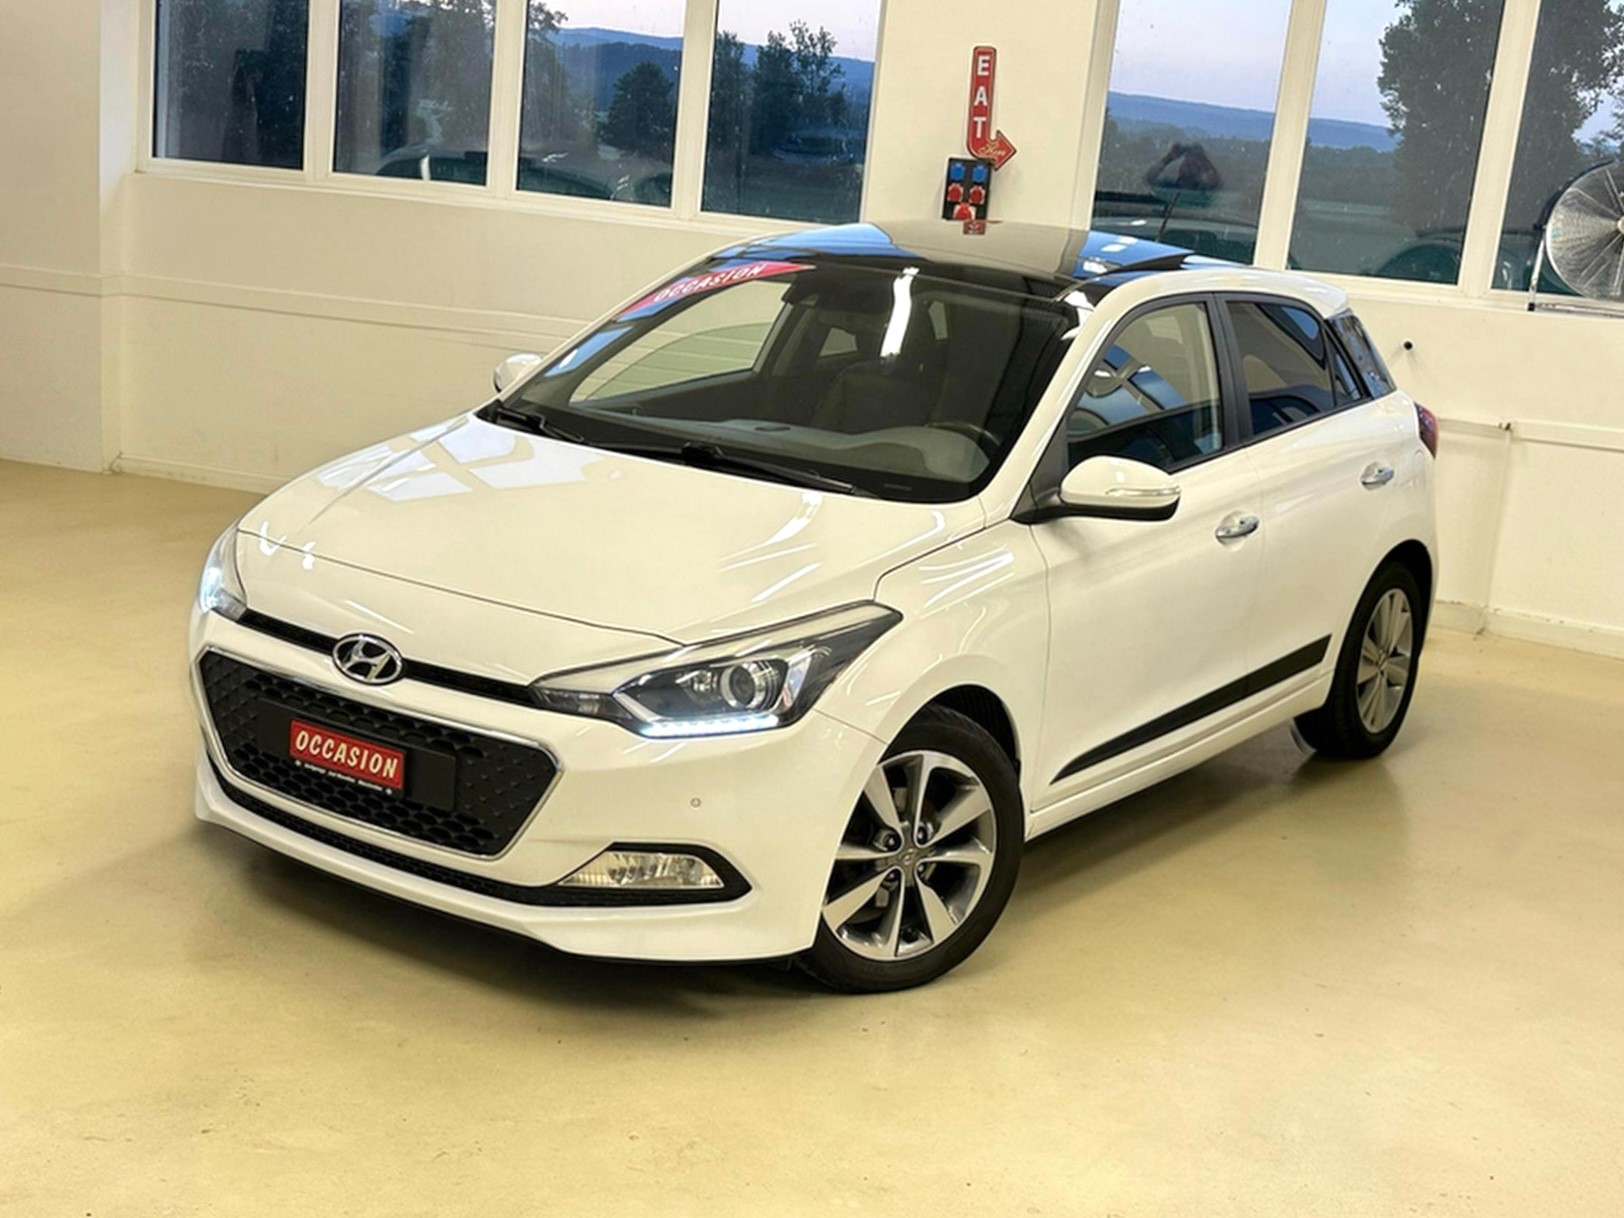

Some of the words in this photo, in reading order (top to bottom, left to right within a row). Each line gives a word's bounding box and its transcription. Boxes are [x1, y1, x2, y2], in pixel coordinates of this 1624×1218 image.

[973, 55, 991, 139] EAT
[653, 263, 767, 302] OCCASION
[295, 730, 398, 779] OCCASION
